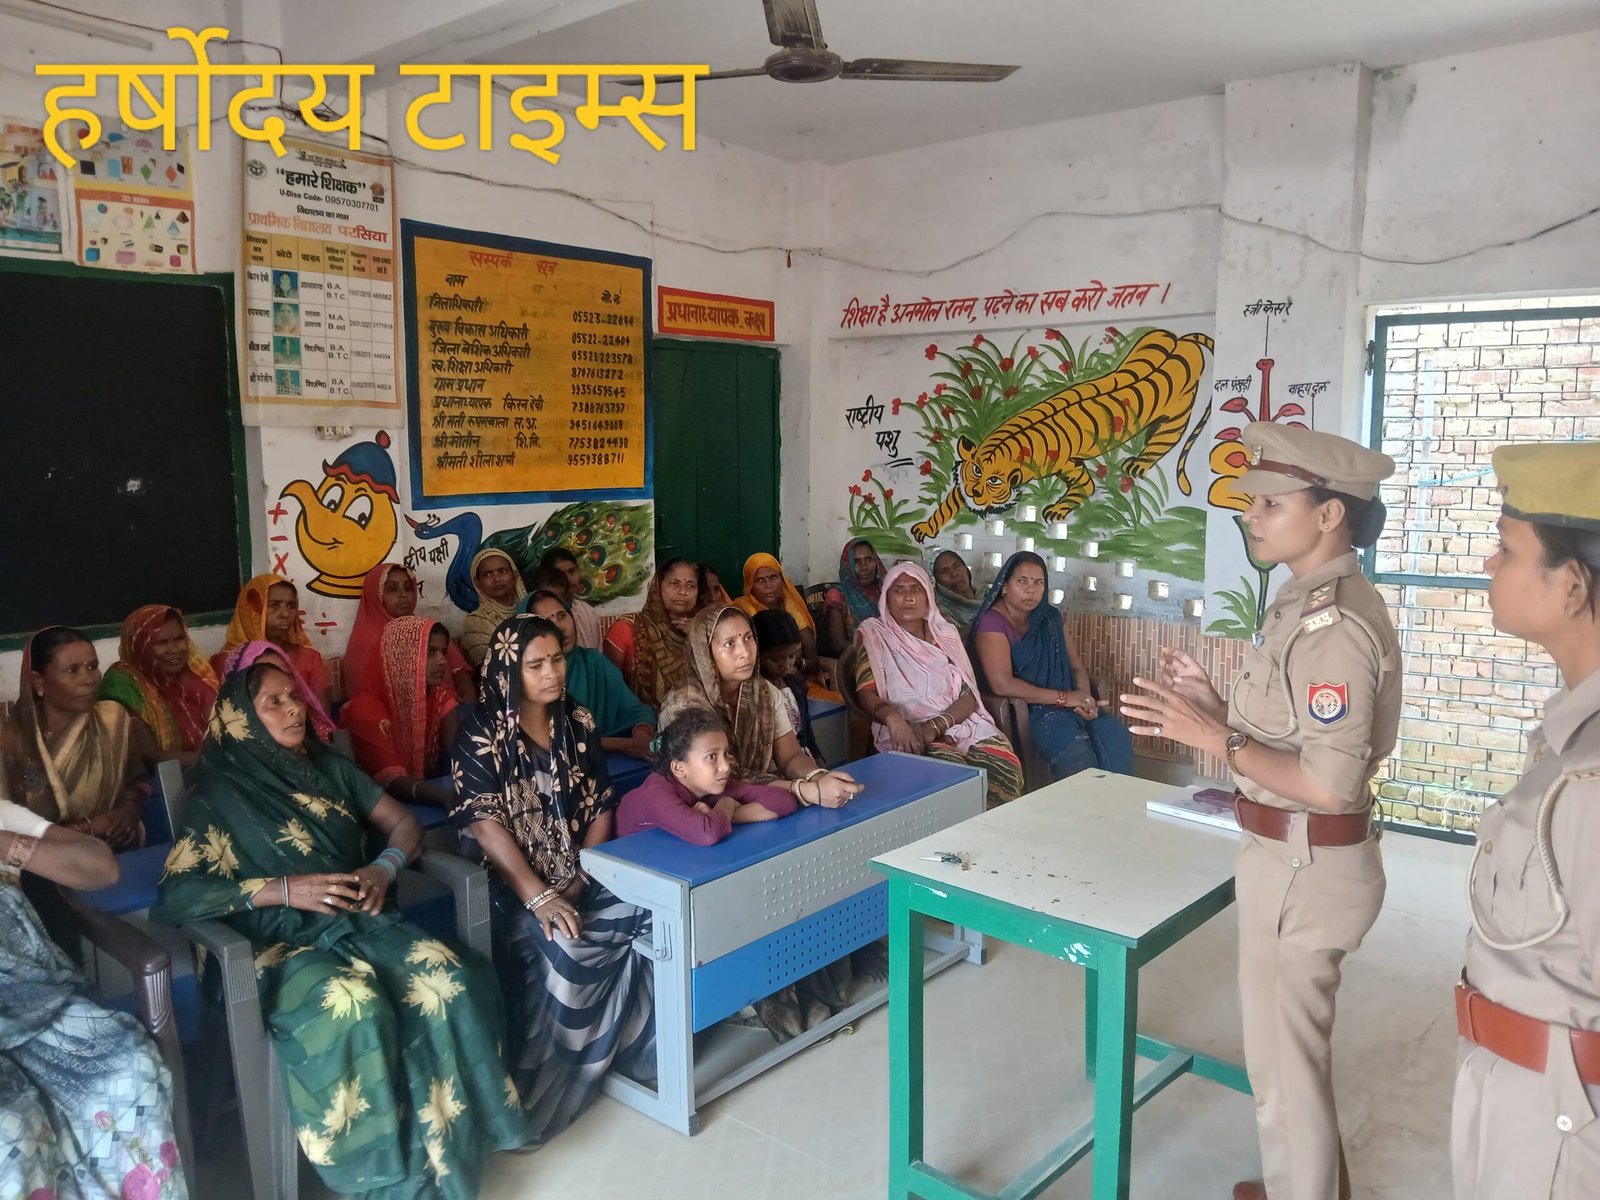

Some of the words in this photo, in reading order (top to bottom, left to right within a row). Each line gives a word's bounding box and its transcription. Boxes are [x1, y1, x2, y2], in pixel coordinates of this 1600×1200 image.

[325, 196, 378, 212] 09570307701
[248, 212, 290, 228] प्राथमिक
[293, 215, 332, 235] विद्यालय
[469, 250, 513, 269] सम्पर्क
[536, 259, 560, 278] सूत्र
[445, 274, 469, 287] नाम
[429, 292, 484, 312] जिलाधिकारी
[840, 296, 877, 329] शिक्षा
[877, 294, 890, 326] है
[890, 296, 943, 324] अनमोल
[1014, 292, 1038, 315] का
[1072, 280, 1107, 311] करो
[1106, 283, 1159, 309] जतन
[666, 302, 740, 328] प्रधानाध्यापक
[454, 316, 487, 337] विकास
[488, 320, 529, 340] अधिकारी
[432, 337, 460, 355] जिला
[492, 341, 531, 359] अधिकारी
[447, 356, 473, 374] शिक्षा
[474, 358, 514, 374] अधिकारी
[434, 378, 455, 392] ग्राम
[456, 378, 486, 392] प्रधान
[1214, 379, 1229, 392] दल
[1311, 381, 1330, 396] दल
[432, 396, 492, 410] प्रधानाध्यापक
[503, 392, 529, 411] किरन
[529, 395, 544, 411] देवी
[845, 394, 885, 429] राष्ट्रीय
[434, 431, 448, 448] श्री
[876, 429, 901, 458] पशु
[436, 451, 467, 470] श्रीमती
[469, 450, 496, 469] शीला
[496, 451, 516, 467] शर्मा
[568, 453, 624, 467] 9559388711
[428, 537, 449, 565] पक्षी
